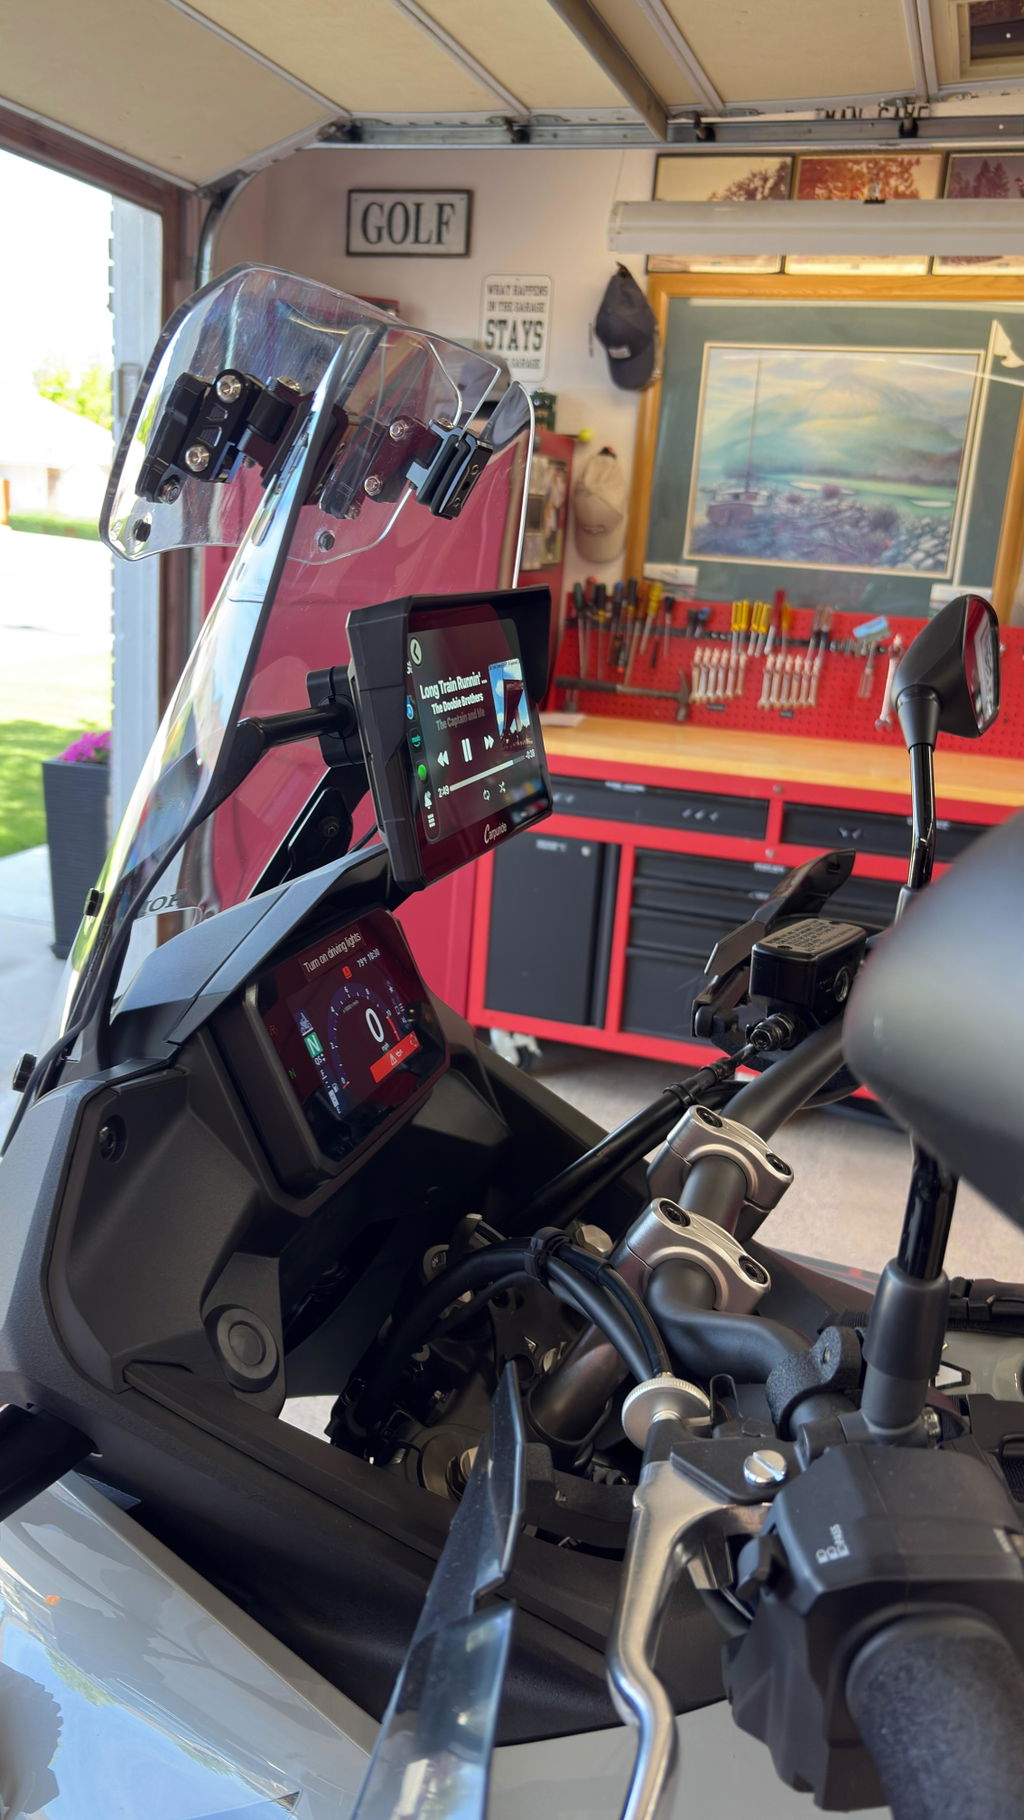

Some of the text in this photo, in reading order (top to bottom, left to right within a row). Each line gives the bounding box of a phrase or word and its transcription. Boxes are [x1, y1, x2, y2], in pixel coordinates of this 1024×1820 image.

[361, 201, 456, 245] GOLF
[487, 285, 511, 296] WHAT
[498, 301, 513, 312] THE
[485, 319, 543, 351] STAYS
[419, 683, 440, 700] Long
[437, 677, 459, 696] Train
[431, 692, 484, 715] The Doobie Brothers
[435, 719, 447, 731] The
[446, 713, 468, 729] Captain
[303, 931, 362, 973] Turn on driving lights
[365, 1008, 384, 1043] 0
[307, 1036, 321, 1053] N
